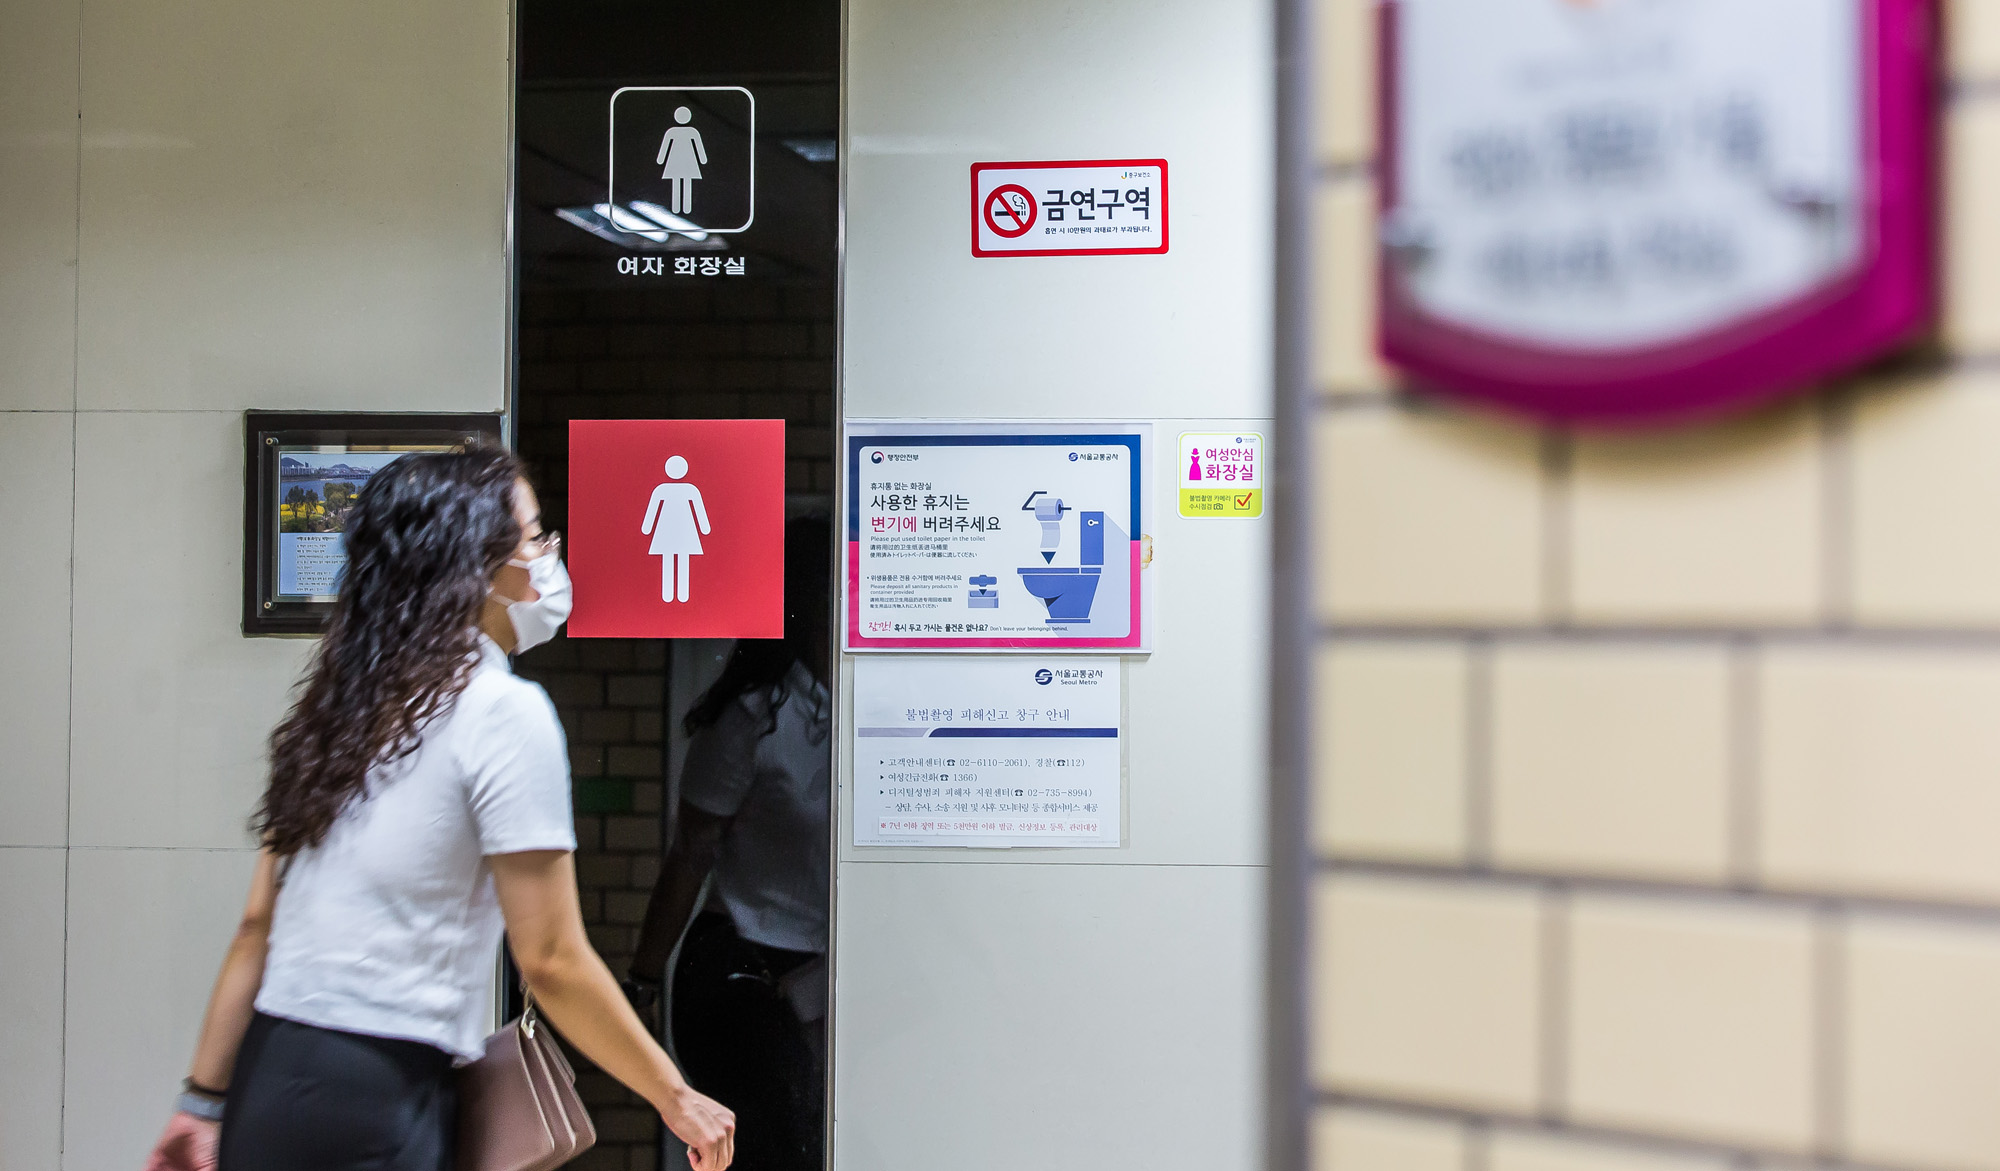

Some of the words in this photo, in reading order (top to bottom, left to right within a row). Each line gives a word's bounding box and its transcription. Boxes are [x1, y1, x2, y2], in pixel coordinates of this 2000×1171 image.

[1042, 186, 1150, 221] 금연구역
[1067, 226, 1092, 234] 10만원의
[1120, 225, 1152, 233] 부과됩니다.
[617, 256, 664, 276] 여자
[674, 256, 745, 276] 화장실
[1080, 453, 1118, 461] 서울교통공사
[1205, 448, 1253, 462] 여성안심
[1205, 464, 1253, 481] 화장실
[870, 482, 892, 490] 휴지통
[894, 482, 908, 490] 없는
[910, 482, 932, 490] 화장실
[870, 494, 917, 511] 사용한
[923, 494, 970, 511] 휴지는
[871, 516, 917, 533] 변기에
[923, 516, 1001, 533] 버려주세요
[911, 574, 933, 582] 수거함에
[934, 574, 962, 582] 버려주세요
[868, 621, 892, 632] 잠깐!
[894, 623, 907, 632] 혹시
[908, 623, 922, 632] 두고
[923, 623, 943, 632] 가시는
[944, 623, 964, 632] 물건은
[965, 623, 988, 632] 없나요?
[1055, 669, 1103, 679] 서울교통공사
[905, 708, 954, 722] 불법촬영
[961, 708, 1009, 722] 피해신고
[1015, 708, 1040, 722] 창구
[1046, 708, 1070, 722] 안내
[888, 788, 940, 797] 디지털성범죄
[945, 788, 971, 797] 피해자
[914, 803, 932, 812] 수사,
[934, 803, 950, 812] 소송
[952, 803, 968, 812] 지원
[970, 803, 979, 812] 및
[980, 803, 997, 812] 사후
[998, 803, 1029, 812] 모니터링
[1031, 803, 1040, 812] 등
[1042, 803, 1080, 812] 종합서비스
[1083, 803, 1098, 812] 제공
[889, 822, 901, 830] 7년
[903, 822, 918, 830] 이하
[937, 822, 951, 830] 또는
[953, 822, 979, 831] 5천만원
[981, 822, 996, 831] 이하
[998, 822, 1015, 831] 벌금,
[1019, 823, 1047, 831] 신상정보
[1069, 823, 1097, 832] 관리대상
